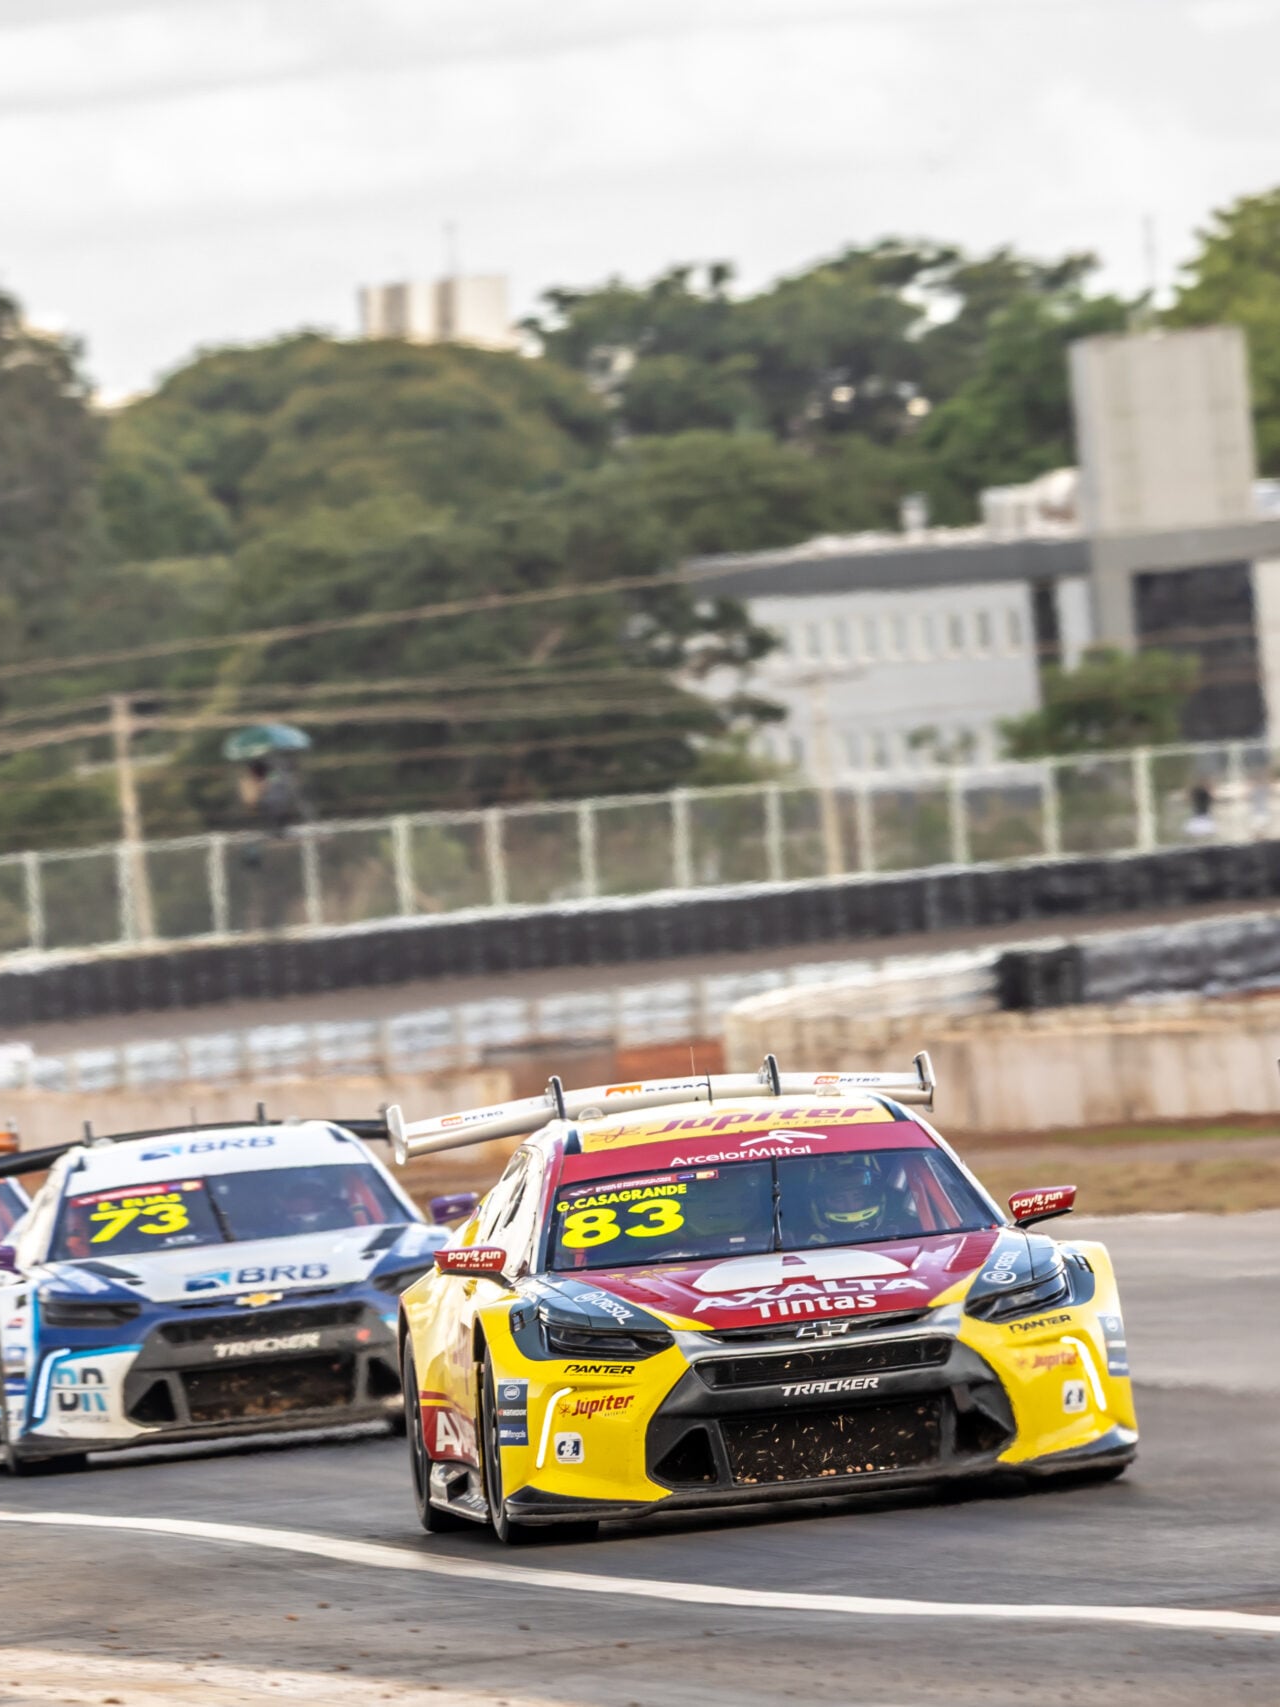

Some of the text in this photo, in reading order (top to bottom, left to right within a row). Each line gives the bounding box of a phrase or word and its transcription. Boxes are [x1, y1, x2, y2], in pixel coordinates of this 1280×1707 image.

[189, 1135, 276, 1154] BRB
[669, 1144, 811, 1167] ArcelorMittal
[556, 1183, 688, 1213] G.CASAGRANDE
[89, 1203, 190, 1243] 73
[561, 1198, 685, 1249] 83
[236, 1263, 329, 1284] BRB
[692, 1277, 930, 1314] AXALTA
[751, 1293, 878, 1319] Tintas
[563, 1364, 636, 1375] PANTER
[781, 1377, 880, 1397] TRACKER
[571, 1394, 635, 1420] Jupiter
